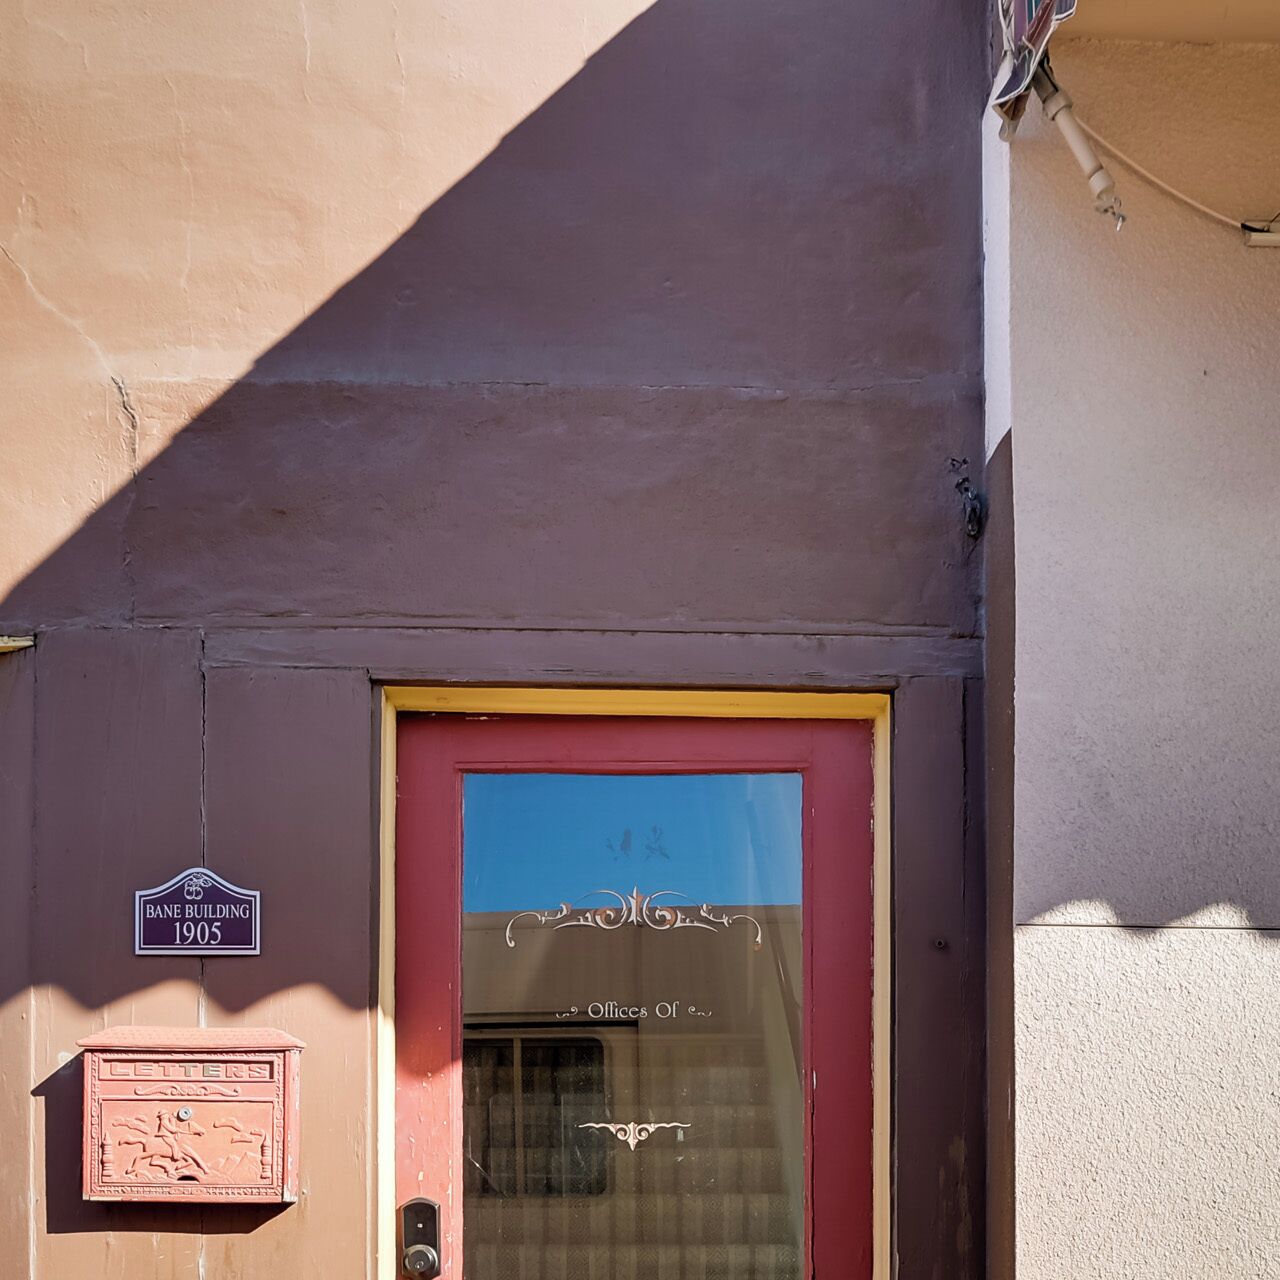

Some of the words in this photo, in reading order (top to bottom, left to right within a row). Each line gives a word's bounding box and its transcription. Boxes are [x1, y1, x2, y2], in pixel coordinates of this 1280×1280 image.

[145, 903, 182, 919] BANE
[184, 903, 250, 919] BUILDING
[173, 921, 222, 945] 1905
[587, 1000, 648, 1019] Offices
[655, 1000, 680, 1018] Of
[109, 1062, 269, 1079] LETTERS
